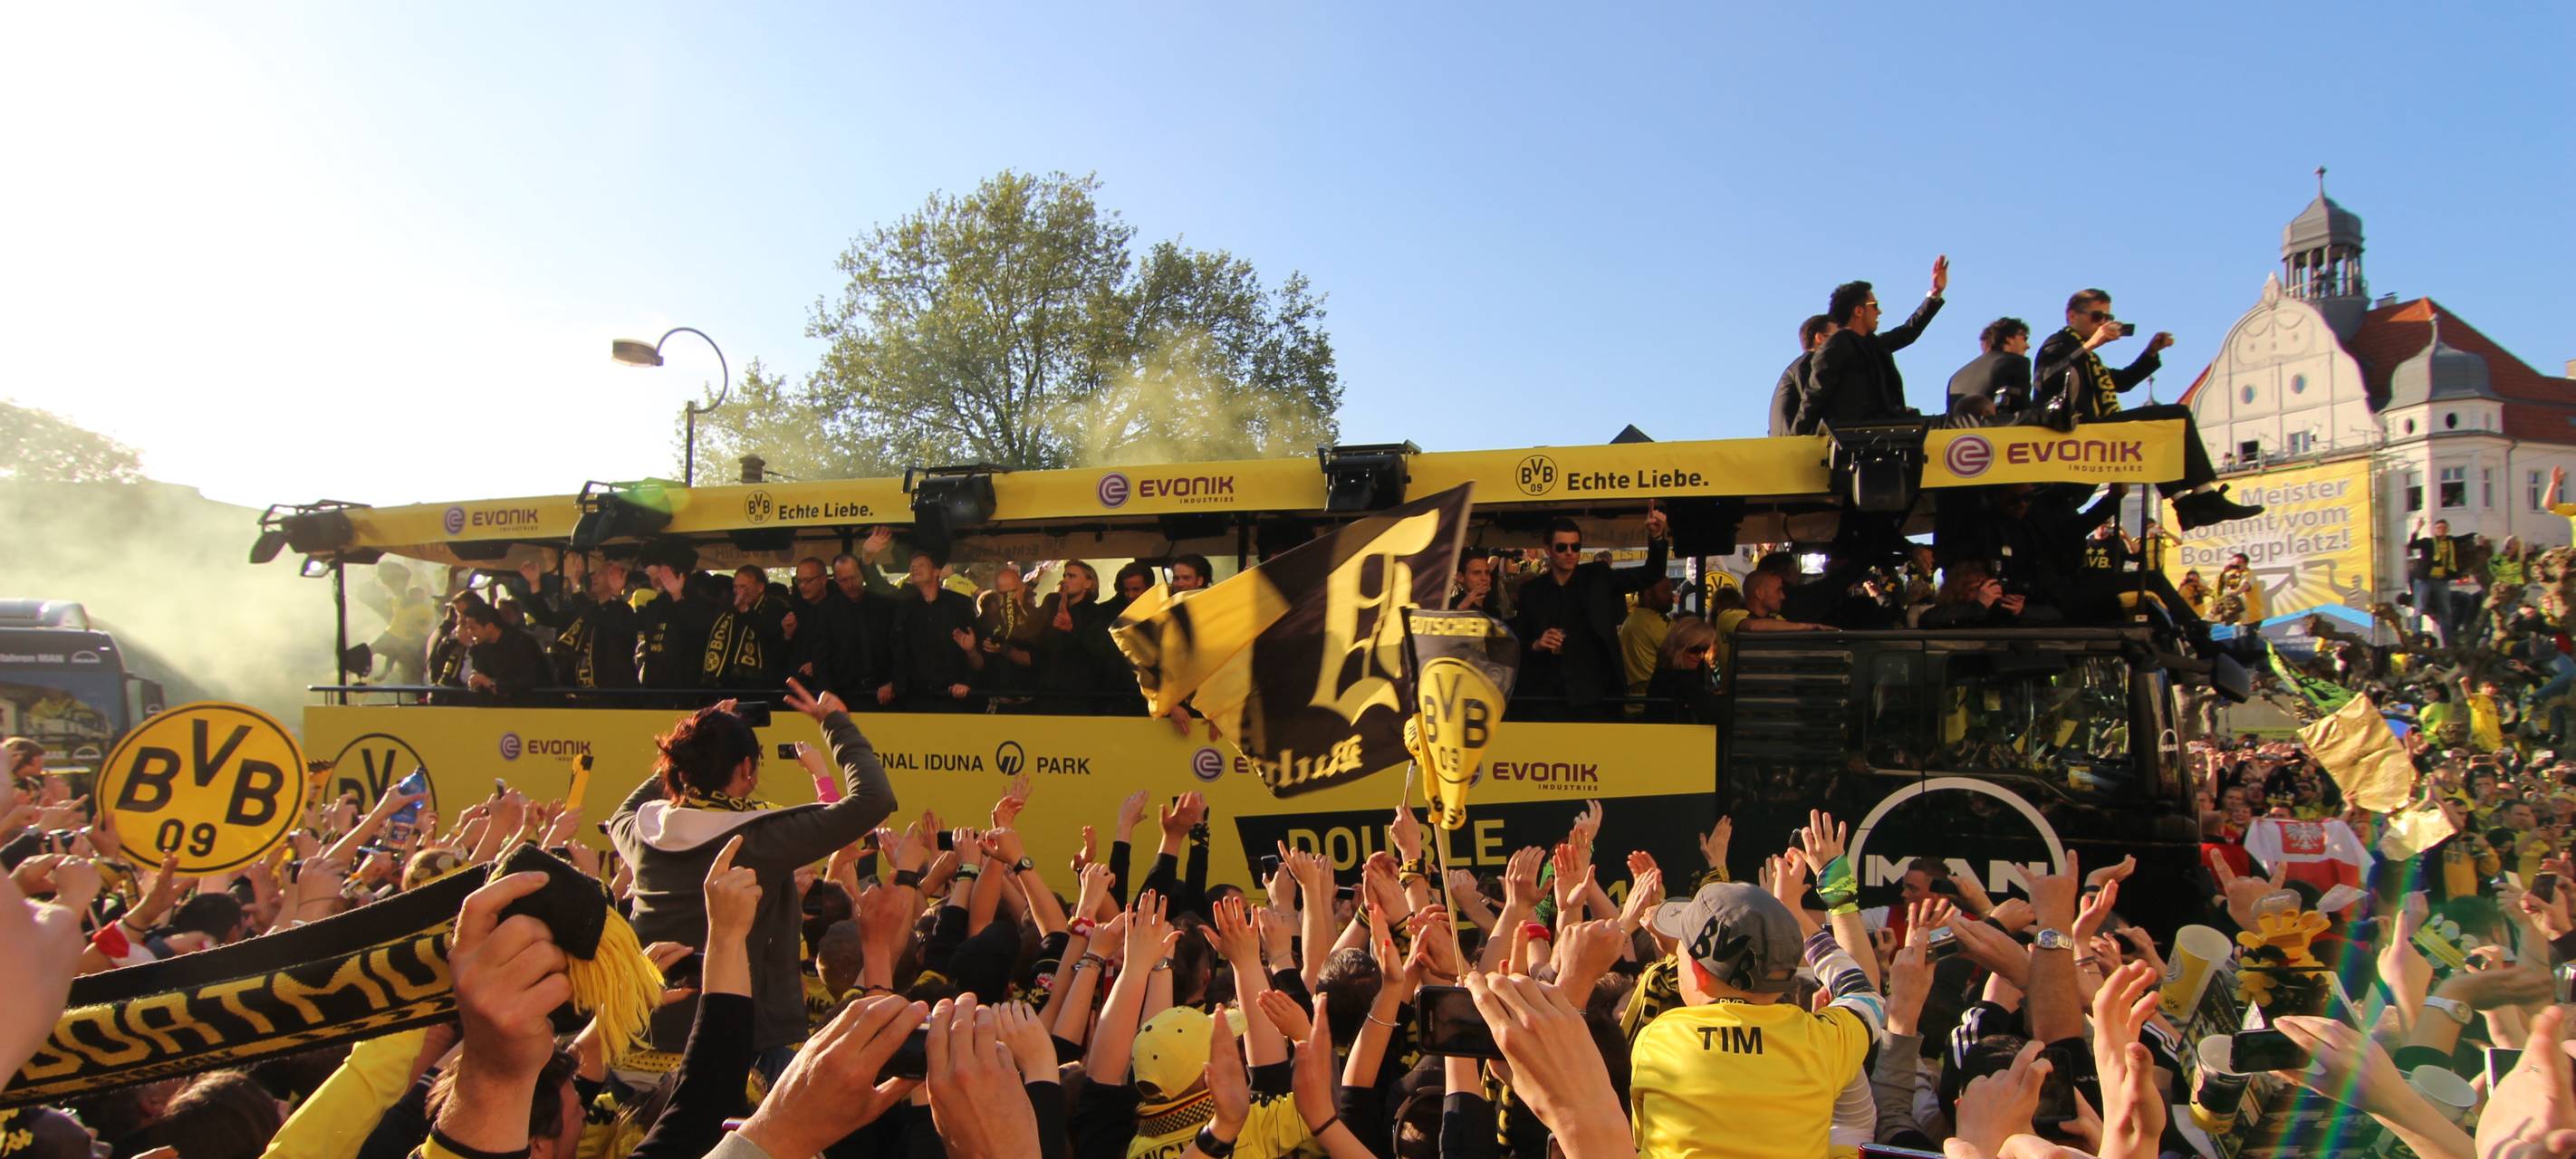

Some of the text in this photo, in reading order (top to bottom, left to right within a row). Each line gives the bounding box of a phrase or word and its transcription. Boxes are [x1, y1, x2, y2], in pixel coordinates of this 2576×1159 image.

[2007, 439, 2143, 464] EVONIK
[1521, 458, 1553, 484] BVB
[1567, 469, 1709, 491] Echte Liebe.
[2069, 465, 2143, 473] INDUSTRIES
[1139, 475, 1235, 497] EVONIK
[1530, 483, 1543, 493] 09
[2240, 478, 2348, 507] Meister
[748, 493, 770, 514] BVB
[779, 502, 873, 520] Echte Liebe.
[1179, 496, 1235, 504] INDUSTRIES
[472, 508, 539, 526] EVONIK
[2284, 506, 2349, 528] vom
[2180, 528, 2350, 565] Borsigplatz!
[2085, 555, 2111, 569] VB.
[1424, 672, 1489, 749] BVB
[528, 739, 591, 755] EVONIK
[115, 718, 284, 828] BVB
[872, 752, 1091, 775] NAL IDUNA PARK
[1492, 761, 1599, 782] EVONIK
[1538, 783, 1599, 791] INDUSTRIES
[156, 819, 216, 857] 09
[1865, 854, 2048, 894] MAN
[1688, 915, 1755, 990] BVB
[1697, 1025, 1764, 1056] TIM
